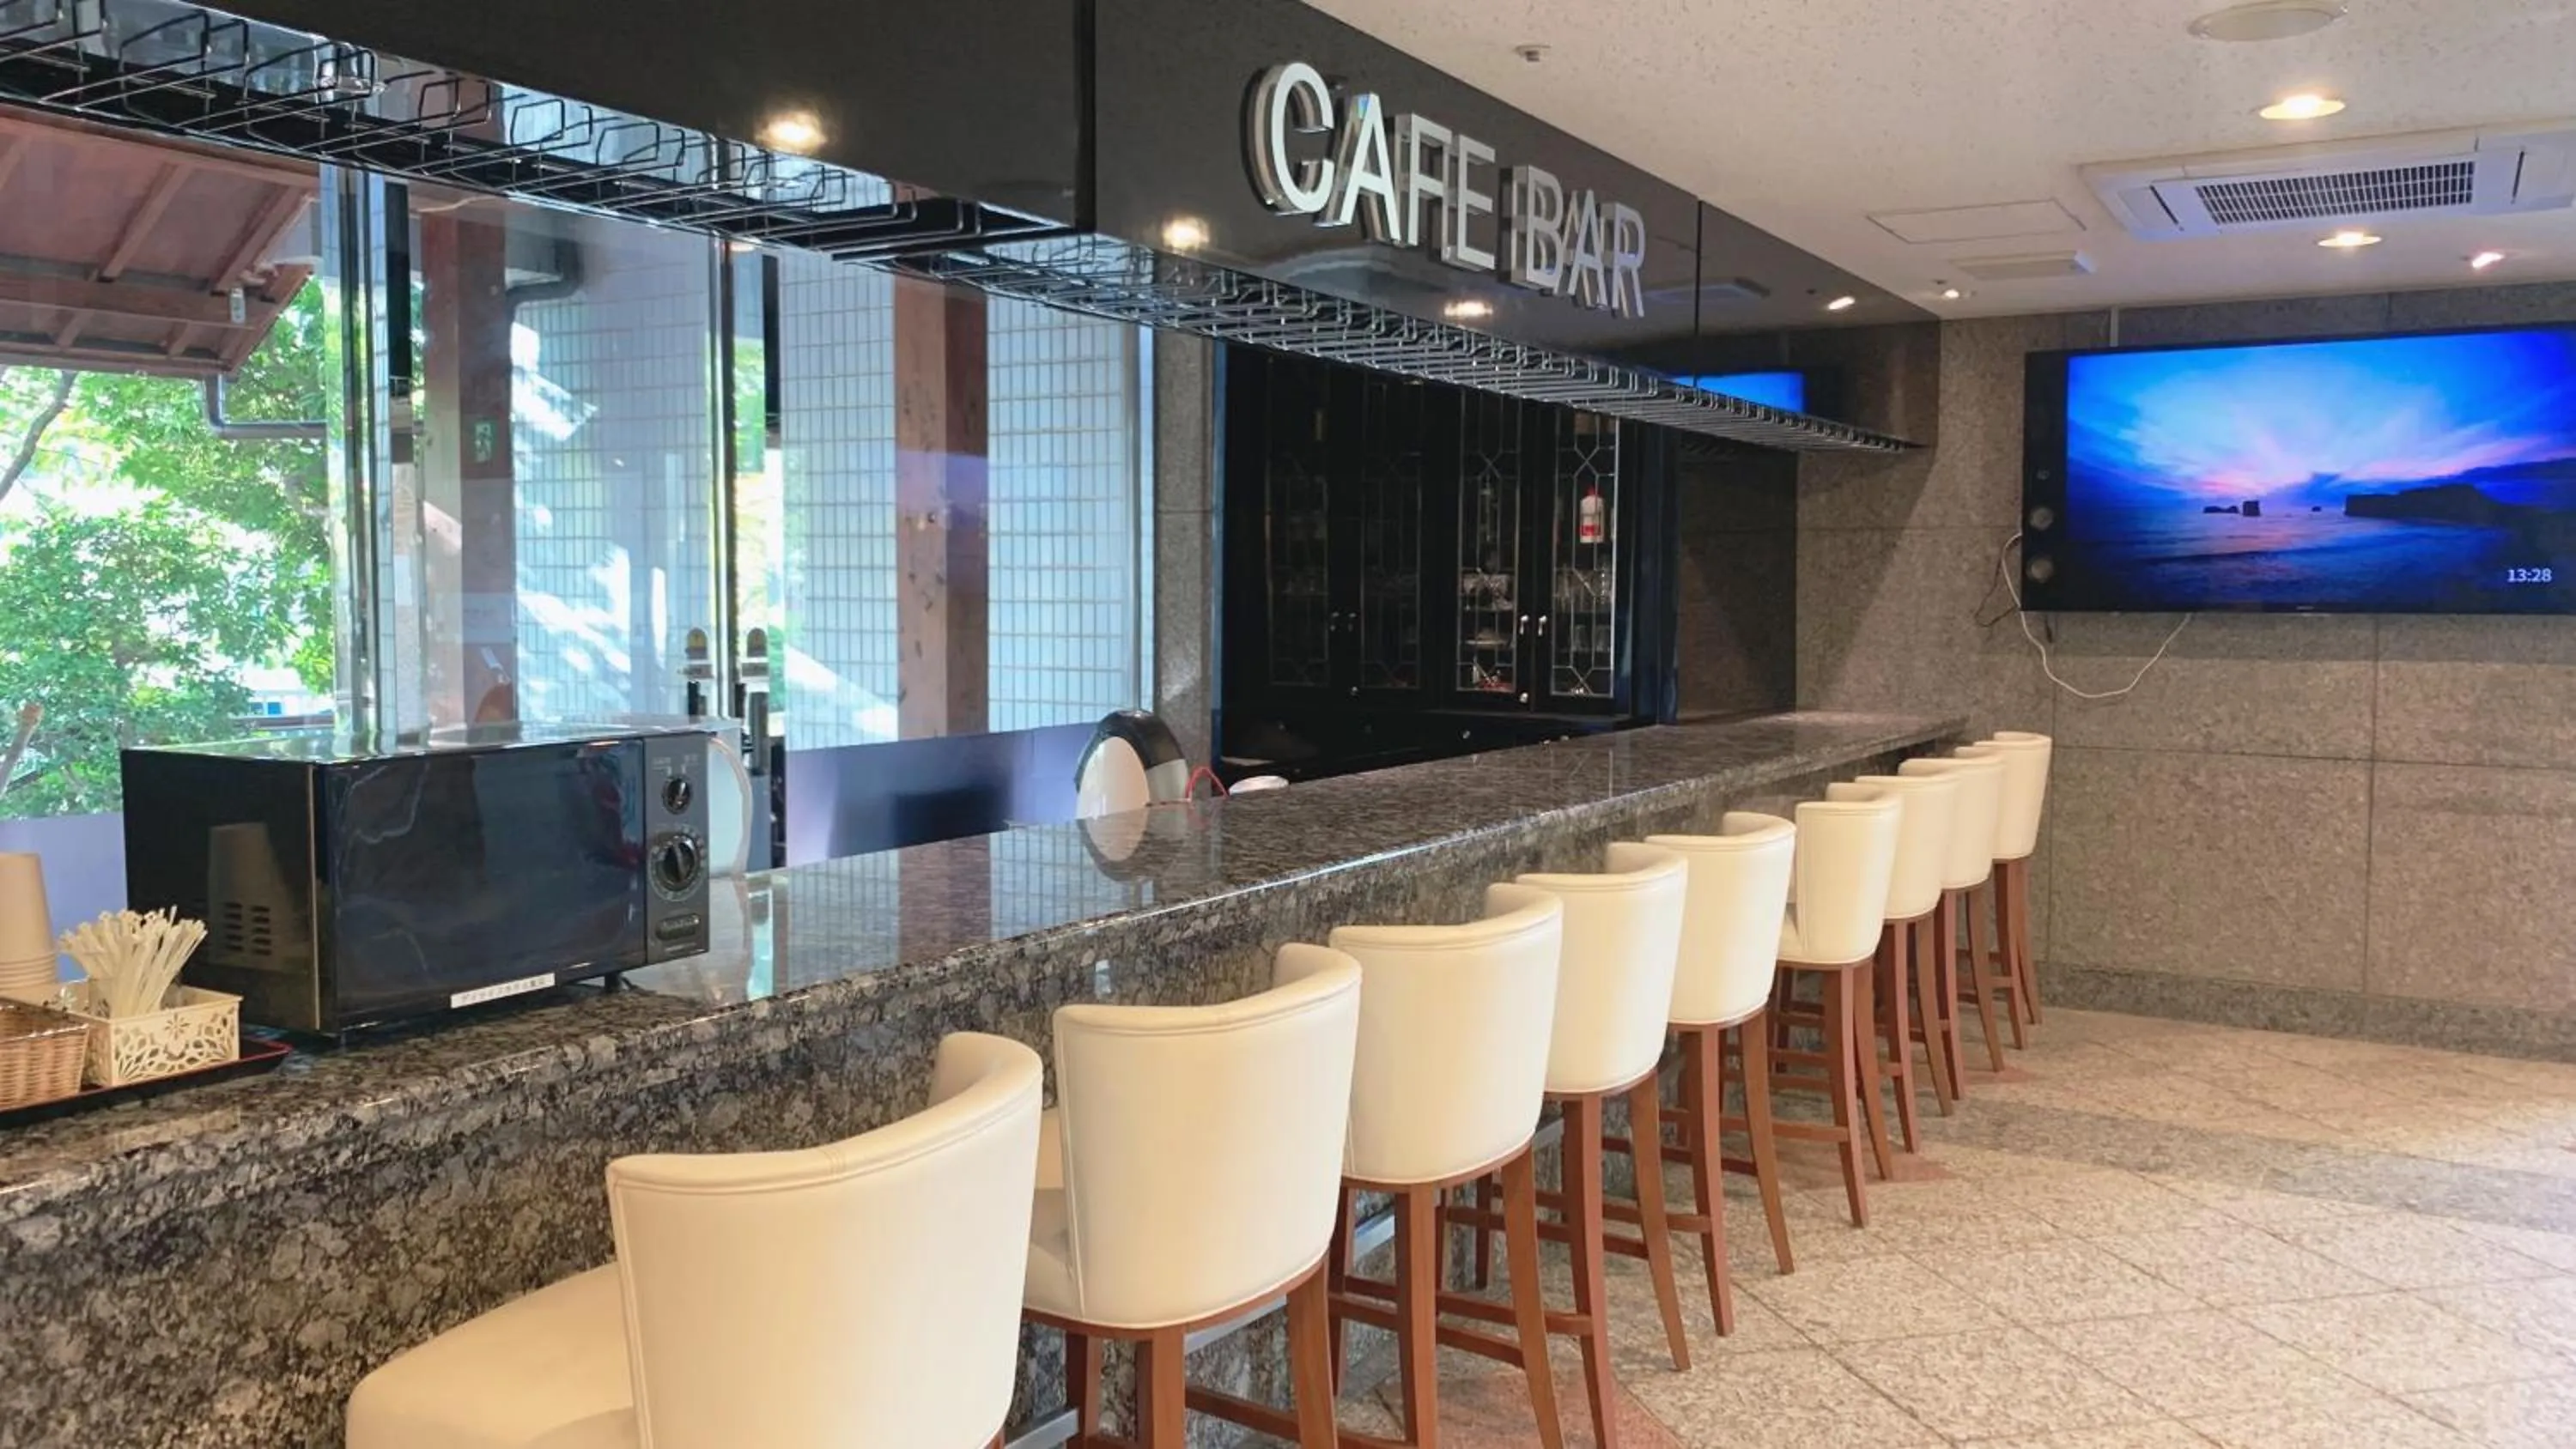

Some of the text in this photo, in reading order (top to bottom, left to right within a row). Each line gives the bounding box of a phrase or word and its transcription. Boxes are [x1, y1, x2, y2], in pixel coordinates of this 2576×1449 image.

[1256, 62, 1646, 318] CAFE BAR
[2507, 567, 2552, 583] 13:28
